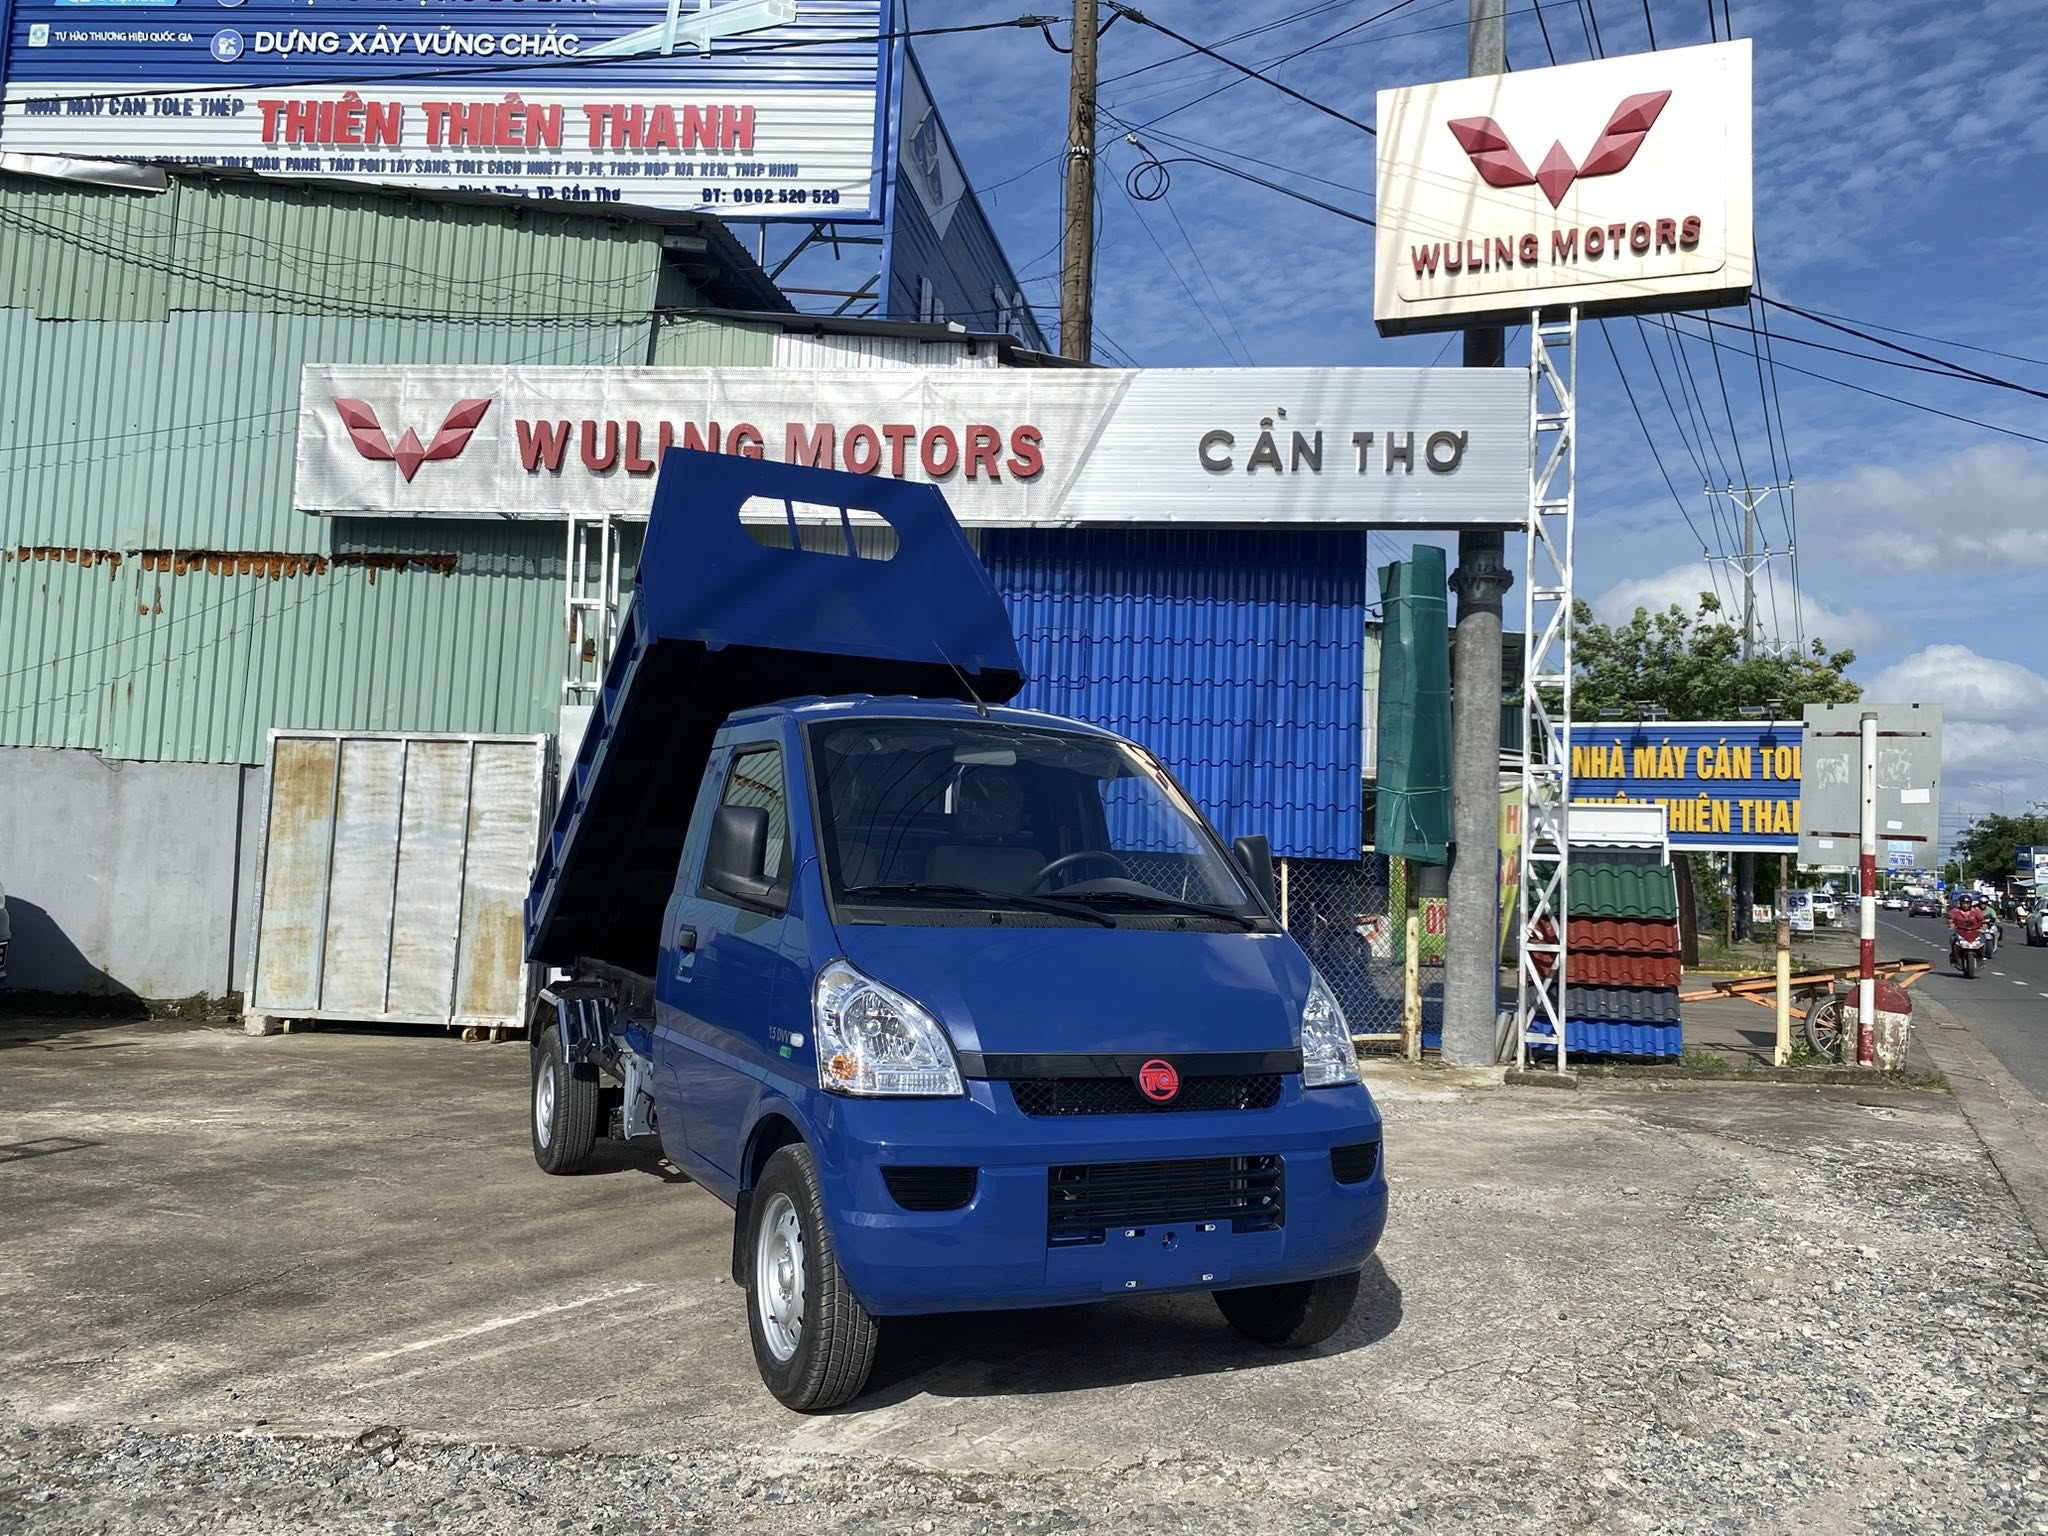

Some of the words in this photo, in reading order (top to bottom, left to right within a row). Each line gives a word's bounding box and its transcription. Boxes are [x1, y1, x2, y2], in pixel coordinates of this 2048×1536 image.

[55, 32, 67, 42] TỰ
[70, 31, 88, 41] HÀO
[129, 33, 148, 43] HIỆU
[150, 31, 176, 42] QUỐC
[178, 34, 193, 42] GIA
[254, 29, 340, 59] DỰNG
[347, 25, 407, 54] XÂY
[413, 25, 496, 56] VỮNG
[500, 23, 580, 56] CHẮC
[152, 97, 194, 116] TOLE
[200, 94, 245, 117] THÉP
[257, 90, 404, 145] THIÊN
[421, 92, 564, 148] THIÊN
[583, 104, 756, 149] THANH
[561, 184, 590, 201] Cần
[595, 187, 621, 202] Thơ
[1411, 233, 1540, 278] WULING
[1551, 215, 1702, 264] MOTORS
[515, 420, 766, 473] WULING
[785, 423, 1046, 479] MOTORS
[1199, 406, 1323, 472] CẦN
[1352, 430, 1469, 473] THƠ
[1572, 738, 1626, 779] NHÀ
[1633, 738, 1689, 779] MÁY
[1697, 738, 1751, 780] CÁN
[1655, 792, 1731, 833] HIÊN
